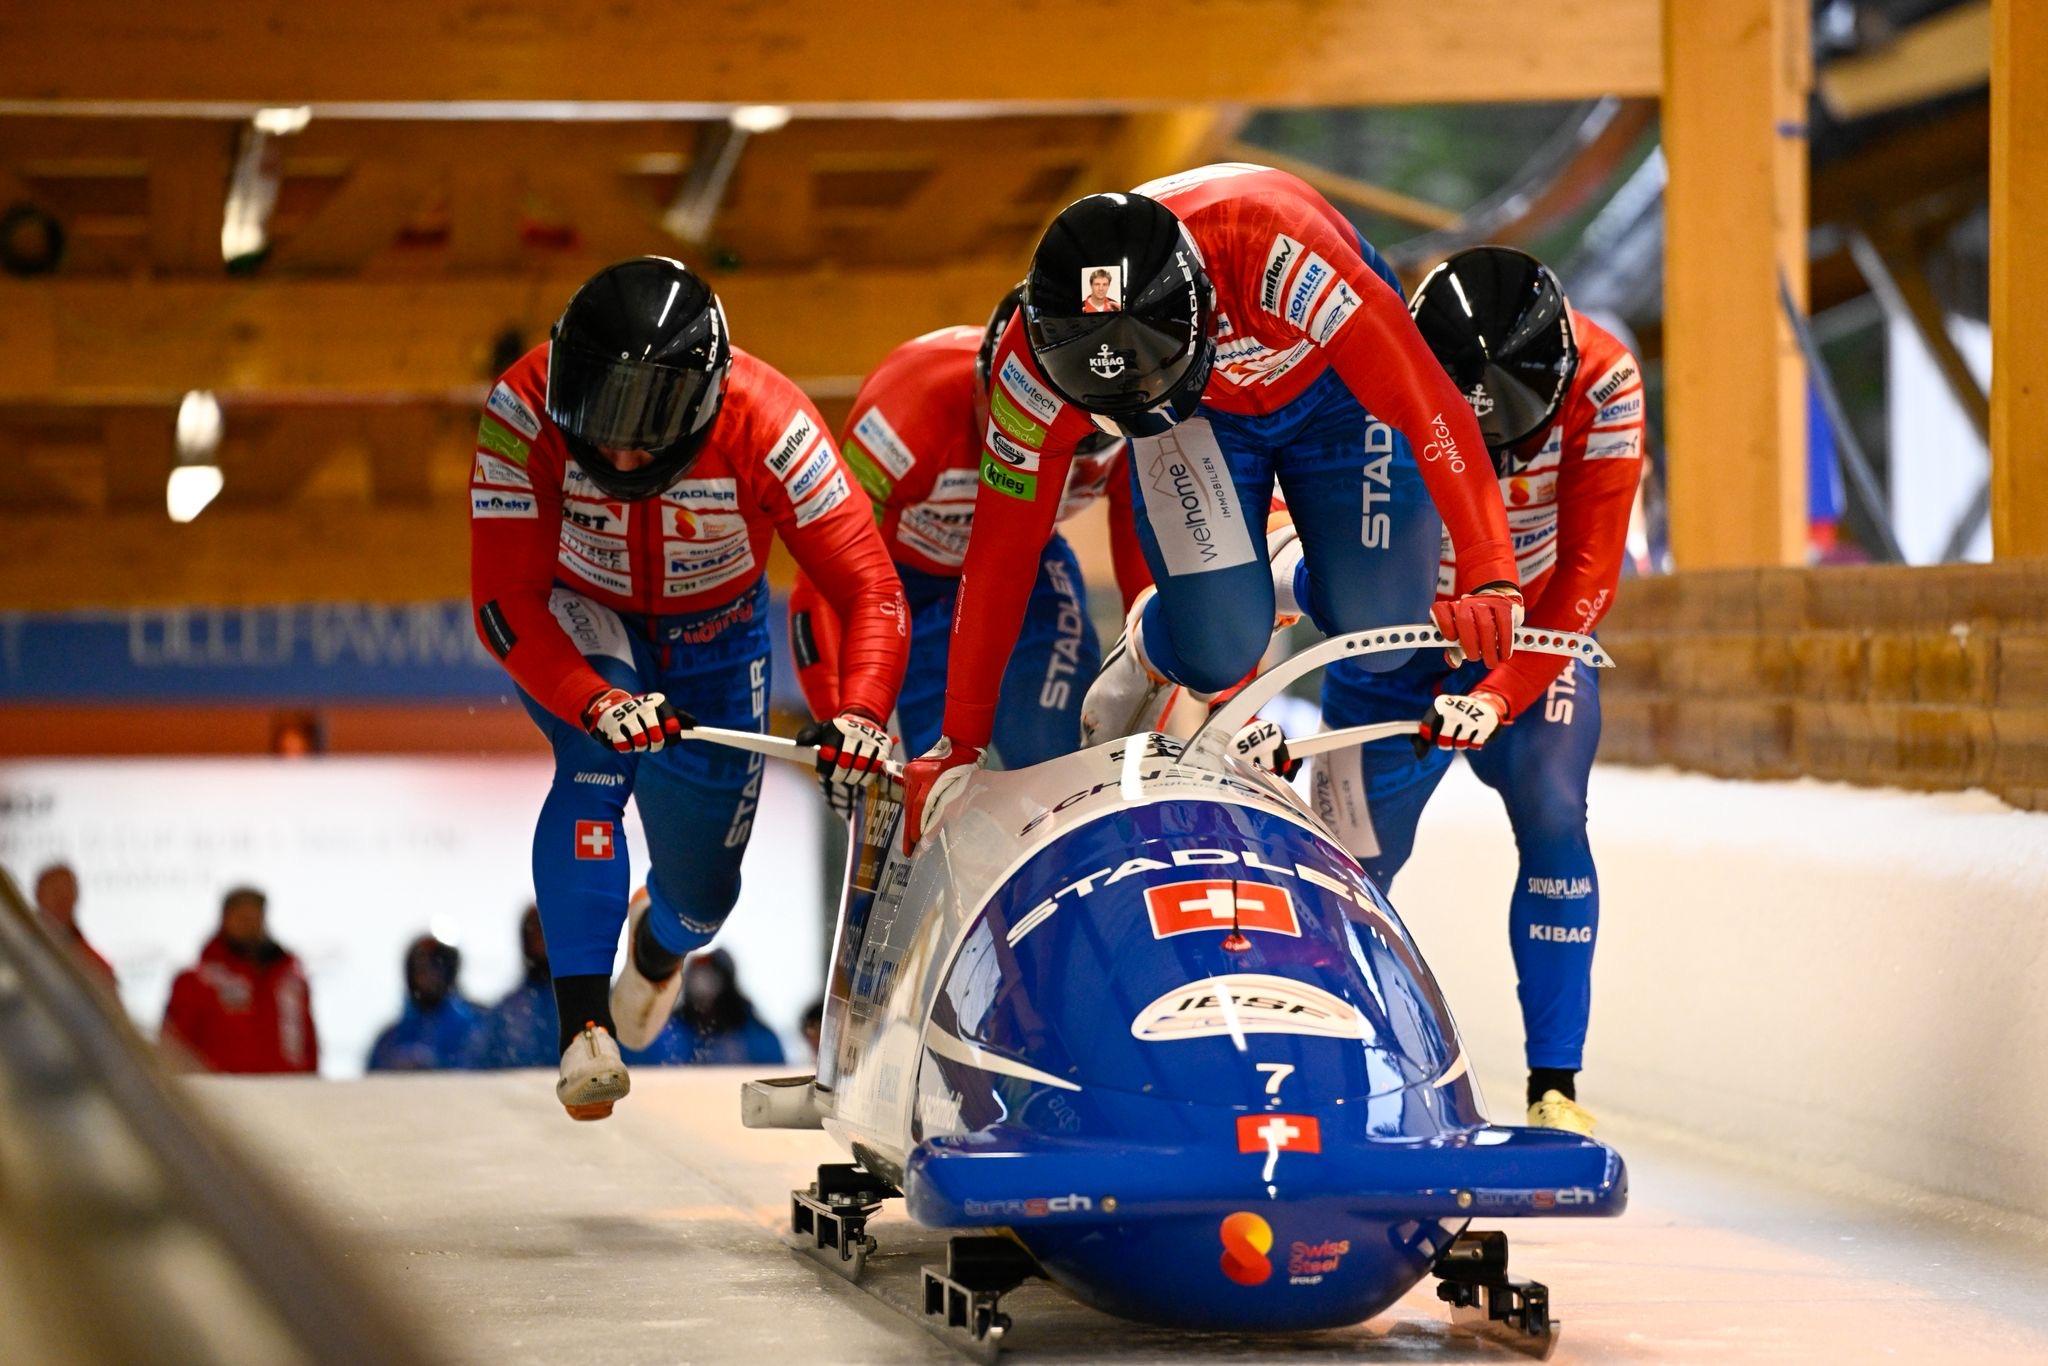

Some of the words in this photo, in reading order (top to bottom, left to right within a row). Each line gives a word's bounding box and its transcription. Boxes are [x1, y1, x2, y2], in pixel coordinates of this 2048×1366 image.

[1262, 239, 1291, 310] innflow
[1289, 263, 1323, 321] KOHLER
[1089, 356, 1124, 367] KIBAG
[1007, 360, 1056, 414] wakutech
[770, 418, 811, 471] innflow
[1431, 413, 1466, 473] OMEGA
[791, 449, 830, 493] KOHLER
[988, 462, 1025, 495] krieg
[1204, 457, 1232, 518] IMMOBILIEN
[1361, 415, 1393, 550] STAD
[664, 489, 735, 501] TADLER
[1040, 559, 1083, 710] STADLER
[1445, 696, 1485, 722] SEIZ
[1236, 722, 1277, 754] SEIZ
[1006, 848, 1403, 949] STADLER
[1528, 876, 1592, 896] SILVAPLANA
[1529, 923, 1592, 943] KIBAG
[1177, 995, 1332, 1020] IBSF
[1255, 1062, 1295, 1094] 7
[1289, 1255, 1338, 1275] Steel
[1291, 1240, 1351, 1259] Swiss
